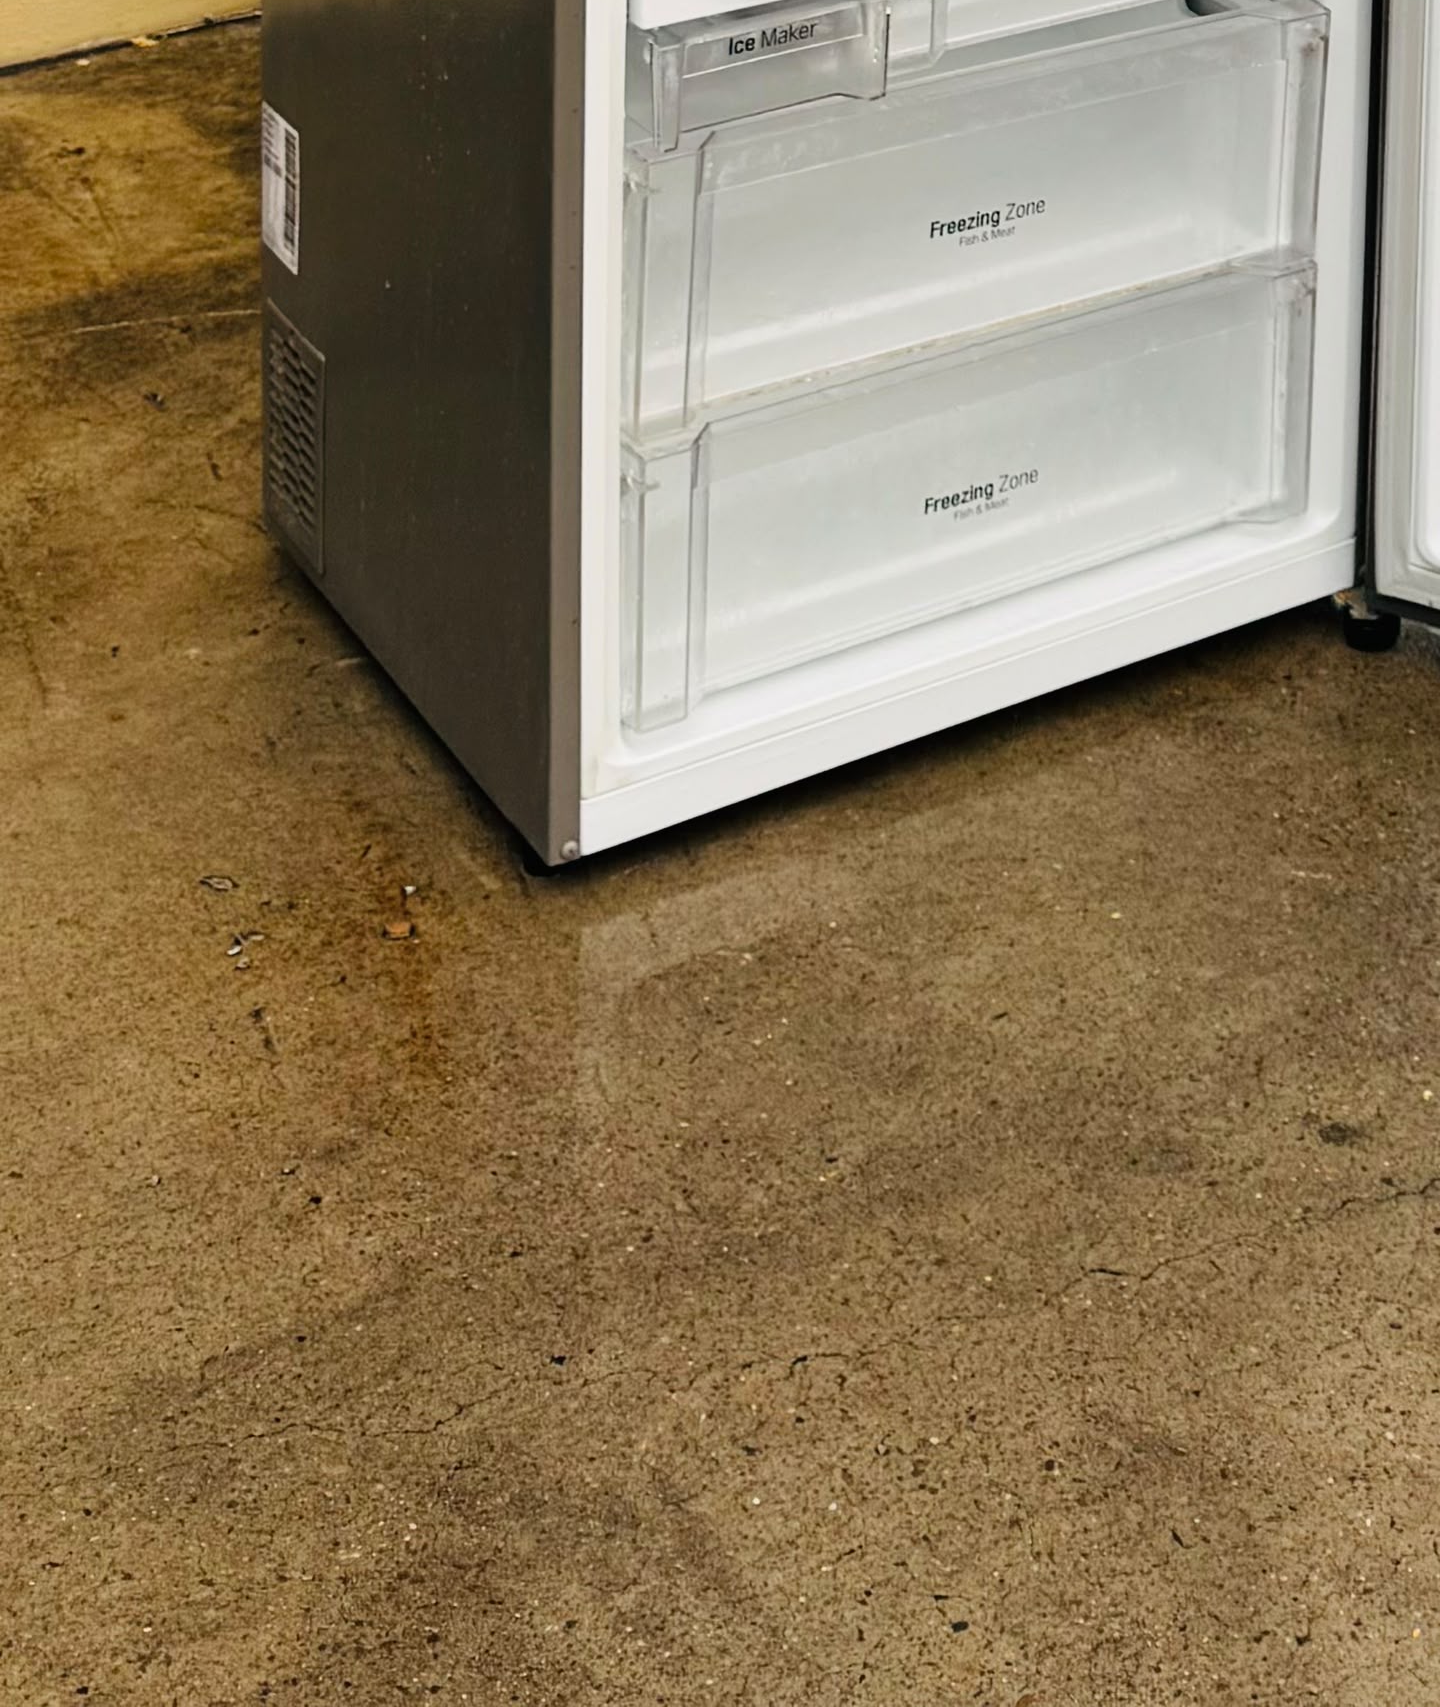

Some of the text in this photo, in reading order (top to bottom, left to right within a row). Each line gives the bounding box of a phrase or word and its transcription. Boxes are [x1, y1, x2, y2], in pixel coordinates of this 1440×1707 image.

[729, 23, 818, 56] Ice Maker
[930, 199, 1045, 239] Freezing Zone
[924, 469, 1038, 515] Freezing Zone
